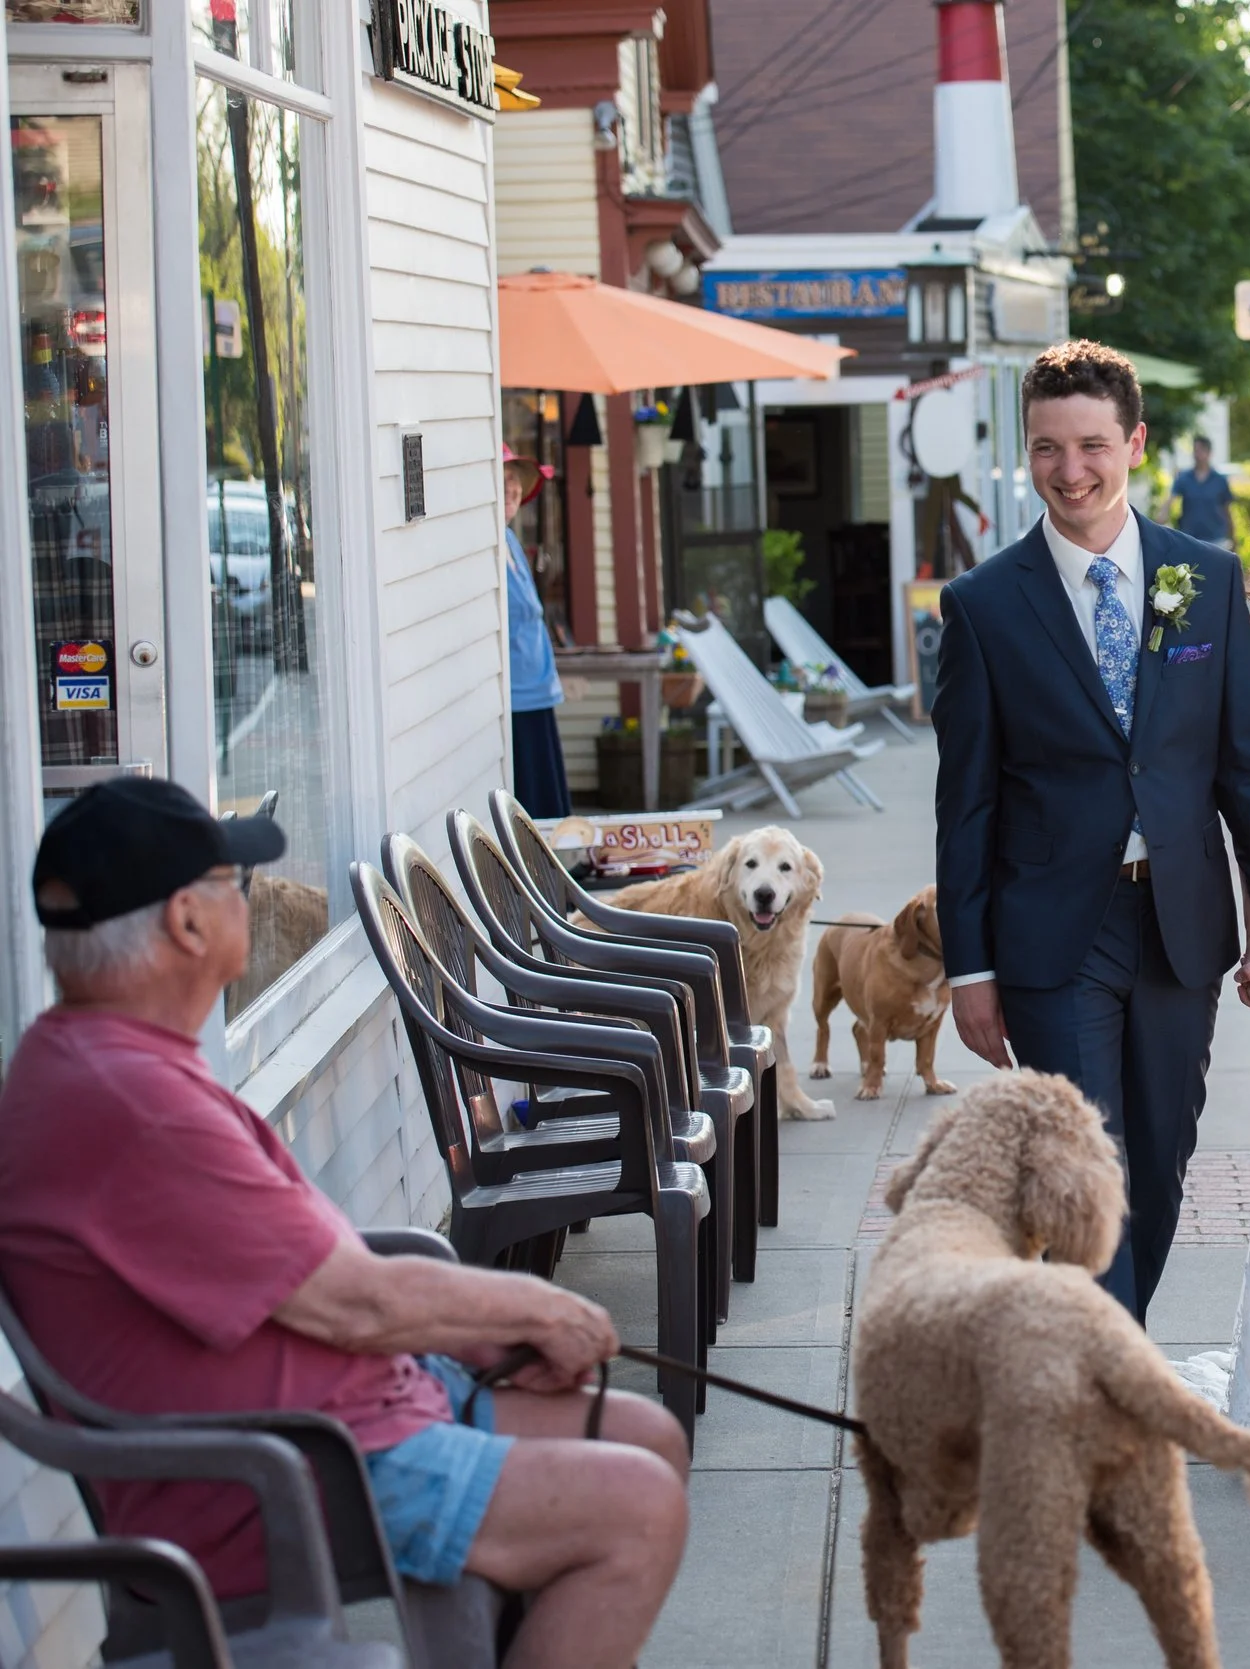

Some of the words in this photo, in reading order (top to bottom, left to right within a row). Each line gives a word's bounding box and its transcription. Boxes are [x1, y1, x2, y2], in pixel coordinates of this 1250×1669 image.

[717, 277, 906, 309] RESTAURAN
[59, 653, 107, 663] MasterCard
[66, 687, 101, 700] VISA
